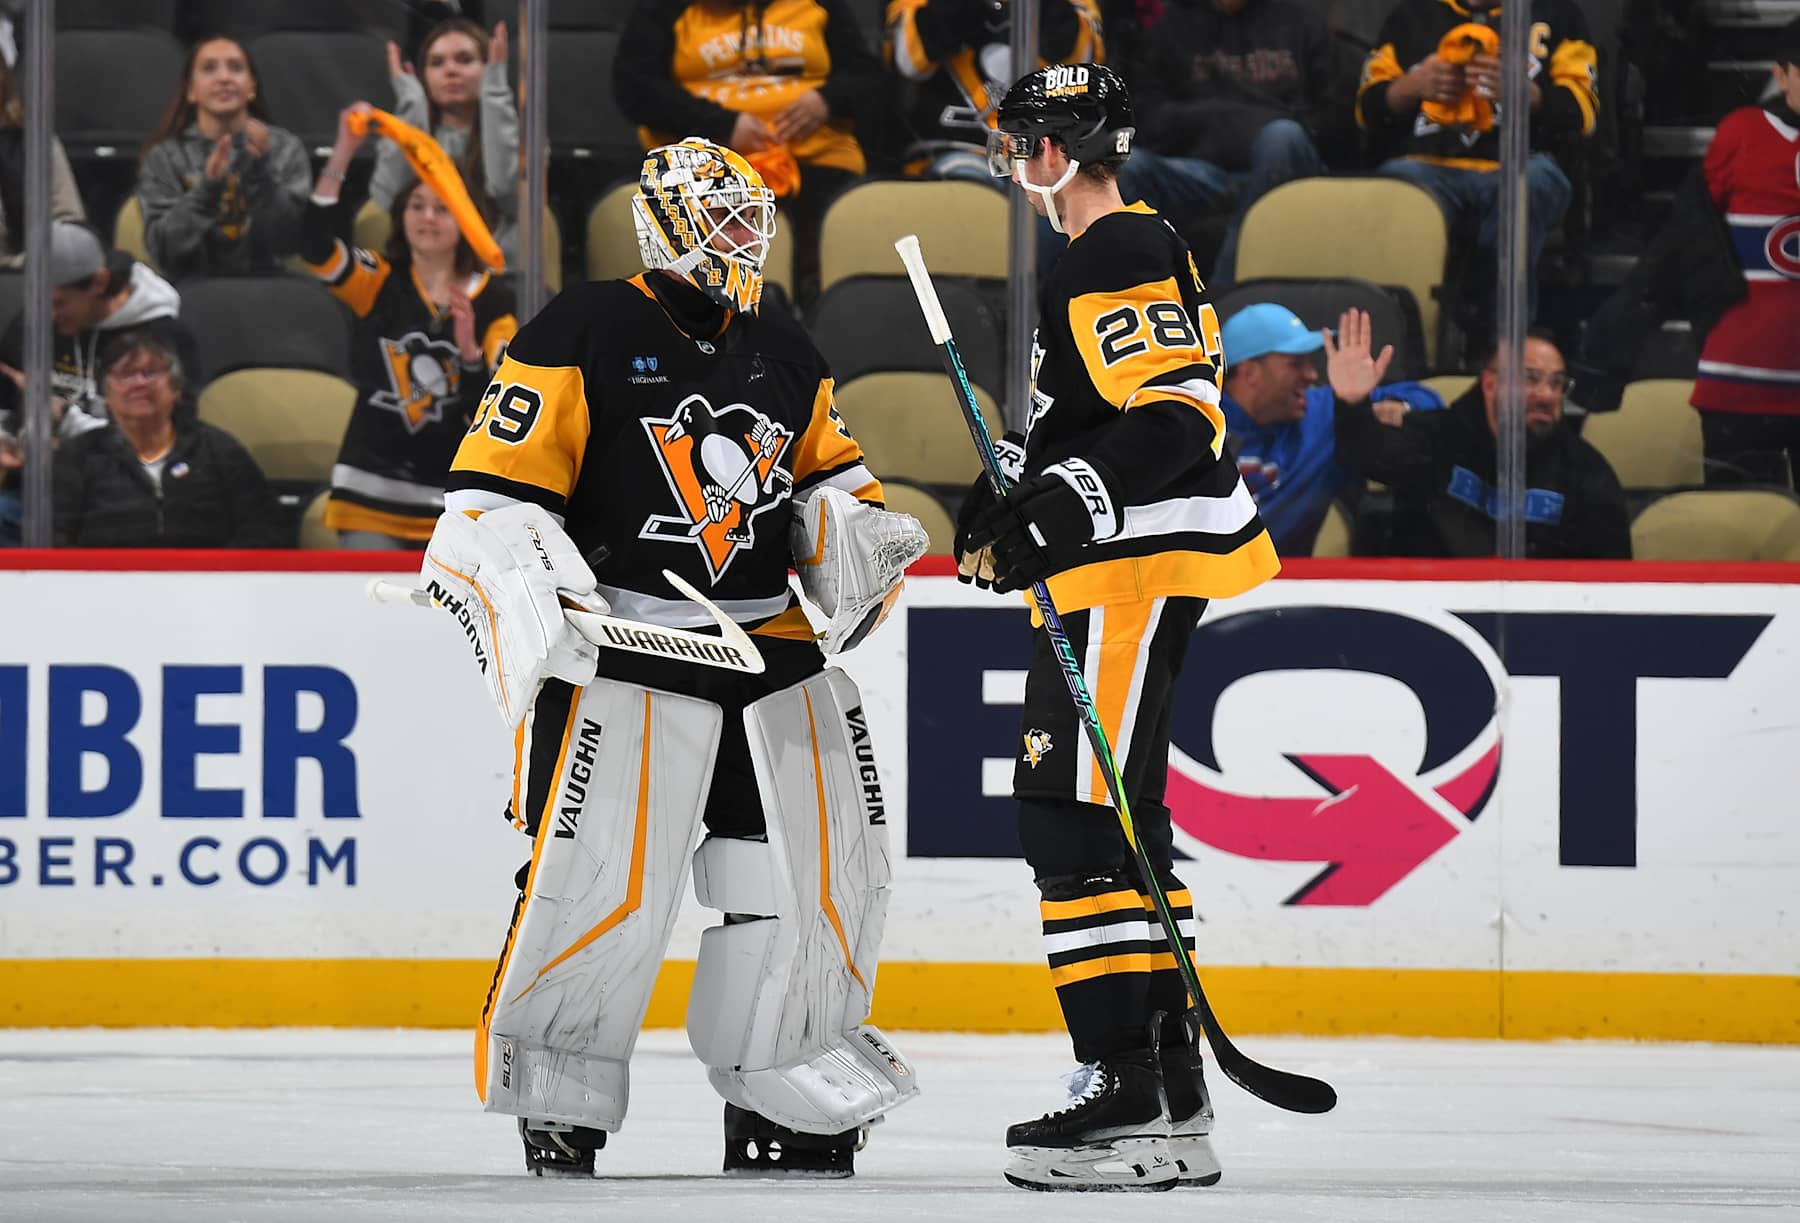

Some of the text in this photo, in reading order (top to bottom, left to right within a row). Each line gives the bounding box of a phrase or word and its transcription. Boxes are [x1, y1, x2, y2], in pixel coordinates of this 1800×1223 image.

[1045, 66, 1089, 90] BOLD
[1045, 85, 1089, 98] PENGUIN
[1115, 132, 1130, 153] 28
[1093, 304, 1199, 369] 28
[466, 380, 544, 446] 39
[426, 580, 488, 675] VAUGHN
[600, 623, 751, 668] WARRIOR
[0, 665, 362, 818] BER
[845, 705, 887, 826] VAUGHN
[554, 717, 603, 840] VAUGHN
